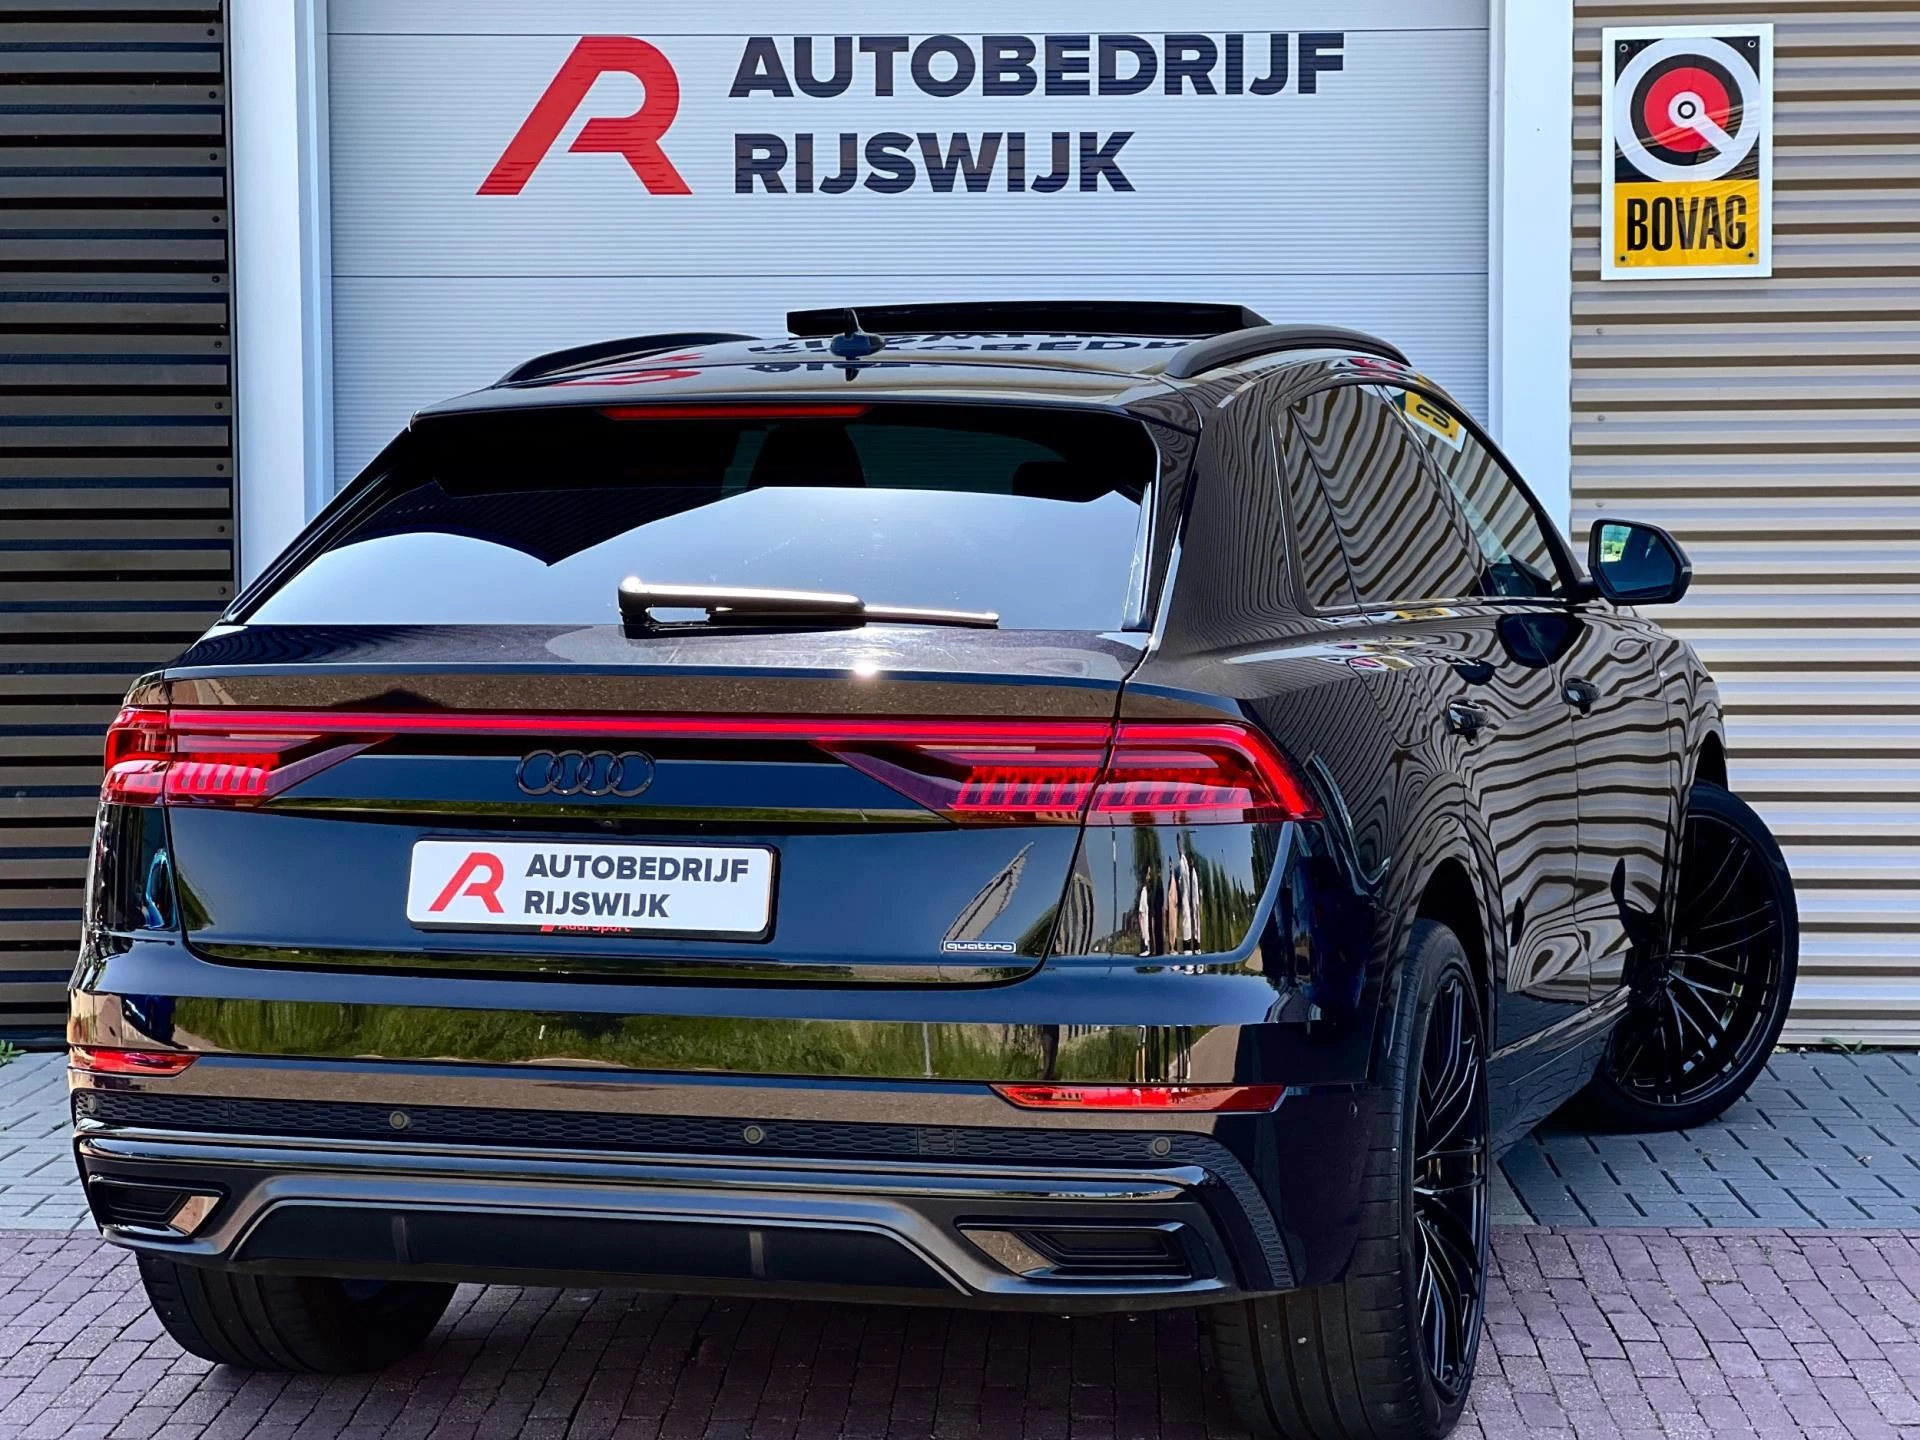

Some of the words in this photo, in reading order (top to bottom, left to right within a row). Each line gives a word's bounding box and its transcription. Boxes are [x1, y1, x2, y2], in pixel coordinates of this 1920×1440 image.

[729, 33, 1345, 98] AUTOBEDRIJF
[735, 131, 1136, 195] RIJSWIJK
[1627, 195, 1747, 251] BOVAG
[526, 853, 749, 883] AUTOBEDRIJF
[523, 890, 670, 918] RIJSWIJK
[946, 942, 1013, 951] quattro
